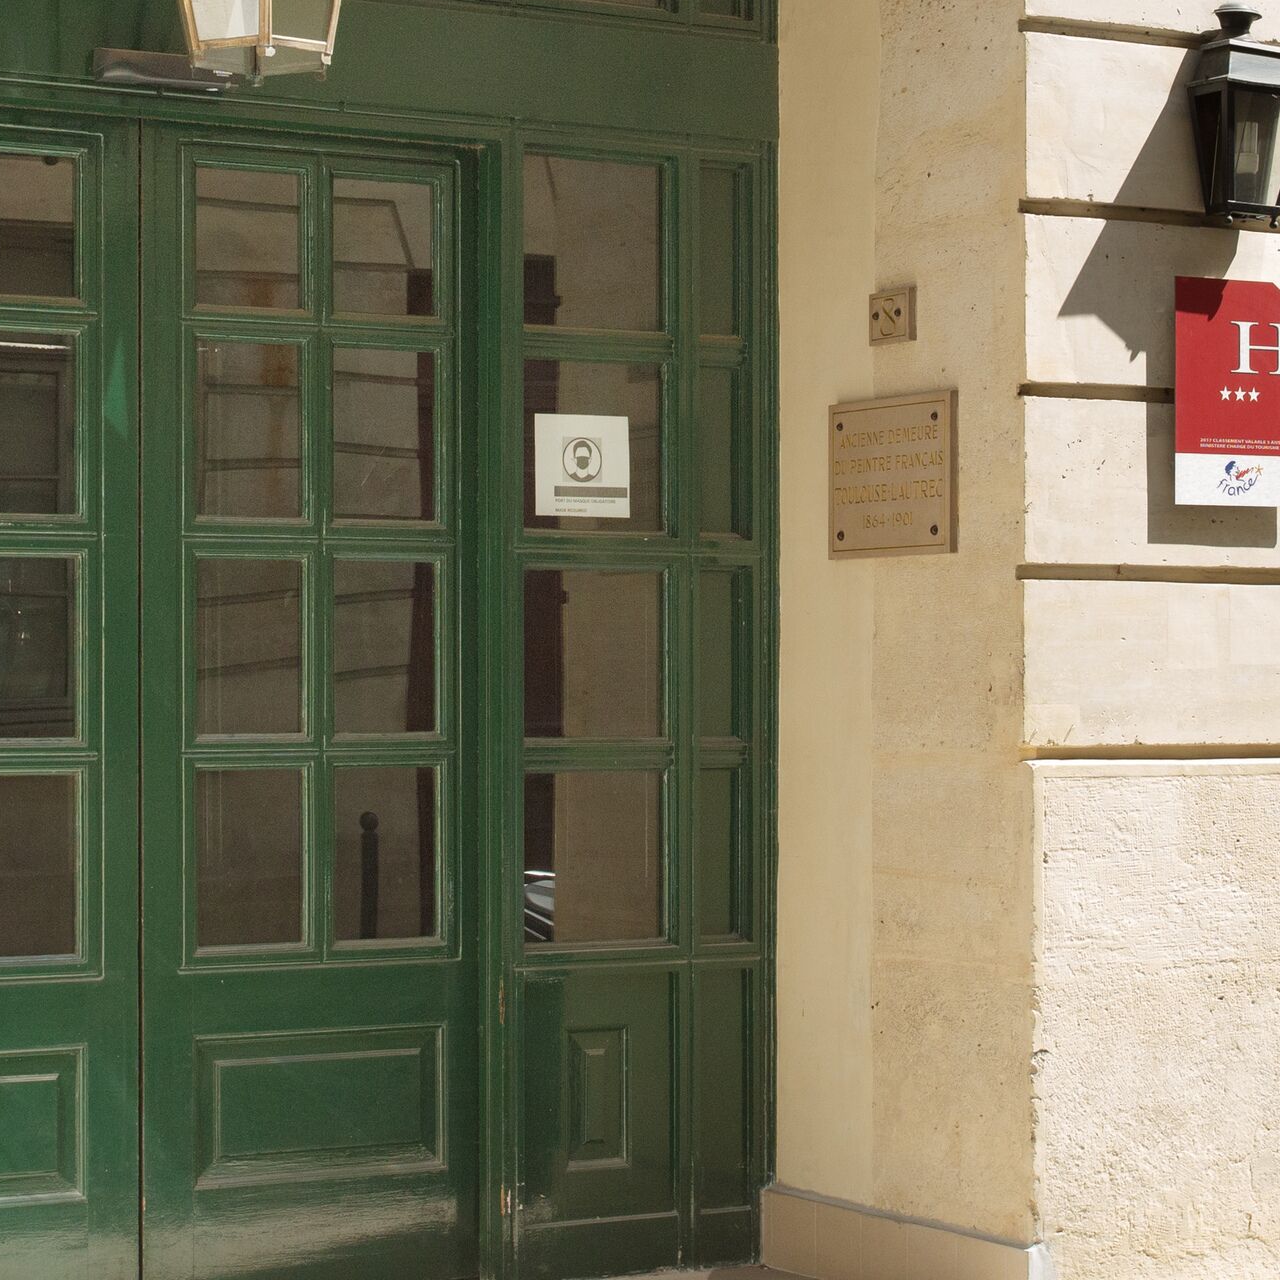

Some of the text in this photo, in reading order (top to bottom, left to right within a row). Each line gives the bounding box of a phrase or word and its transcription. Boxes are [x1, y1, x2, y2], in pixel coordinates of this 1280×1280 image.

[840, 424, 938, 449] ANCIENNE DEMEURE
[850, 456, 891, 474] PEINTRE
[895, 450, 944, 470] FRANÇAIS
